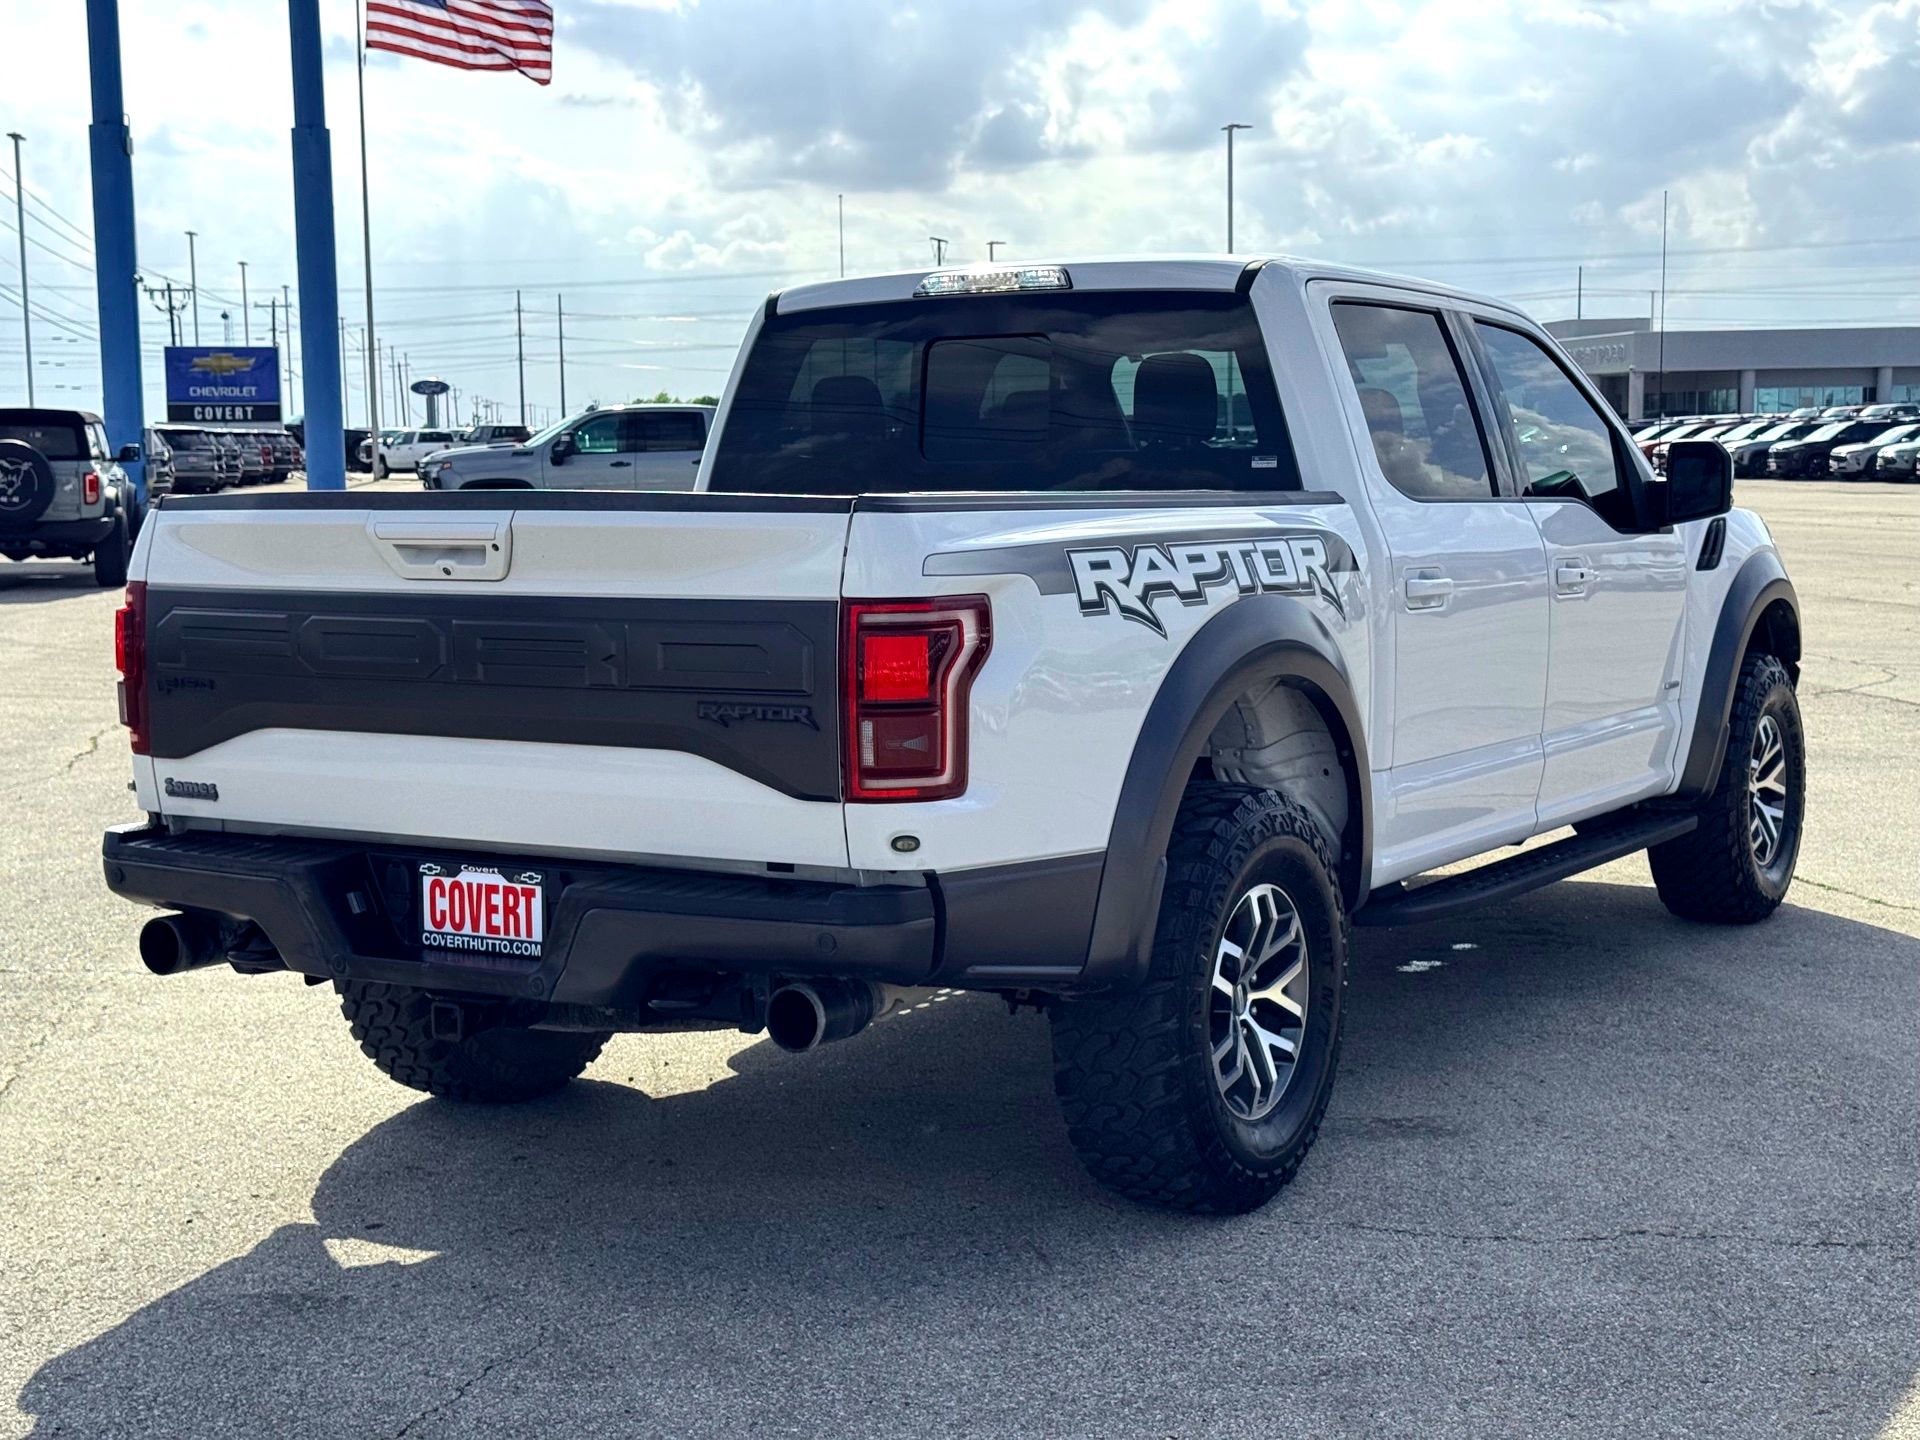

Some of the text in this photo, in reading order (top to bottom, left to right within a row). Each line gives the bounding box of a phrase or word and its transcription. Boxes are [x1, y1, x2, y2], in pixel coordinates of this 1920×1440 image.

[189, 386, 257, 397] CHEVROLET
[194, 406, 254, 420] COVERT
[1064, 535, 1347, 640] RAPTOR
[156, 608, 814, 697] FORD
[697, 701, 820, 731] RAPTOR
[460, 864, 499, 875] Covert
[429, 878, 536, 939] COVERT
[422, 932, 542, 957] COVERTHUTTO.COM
